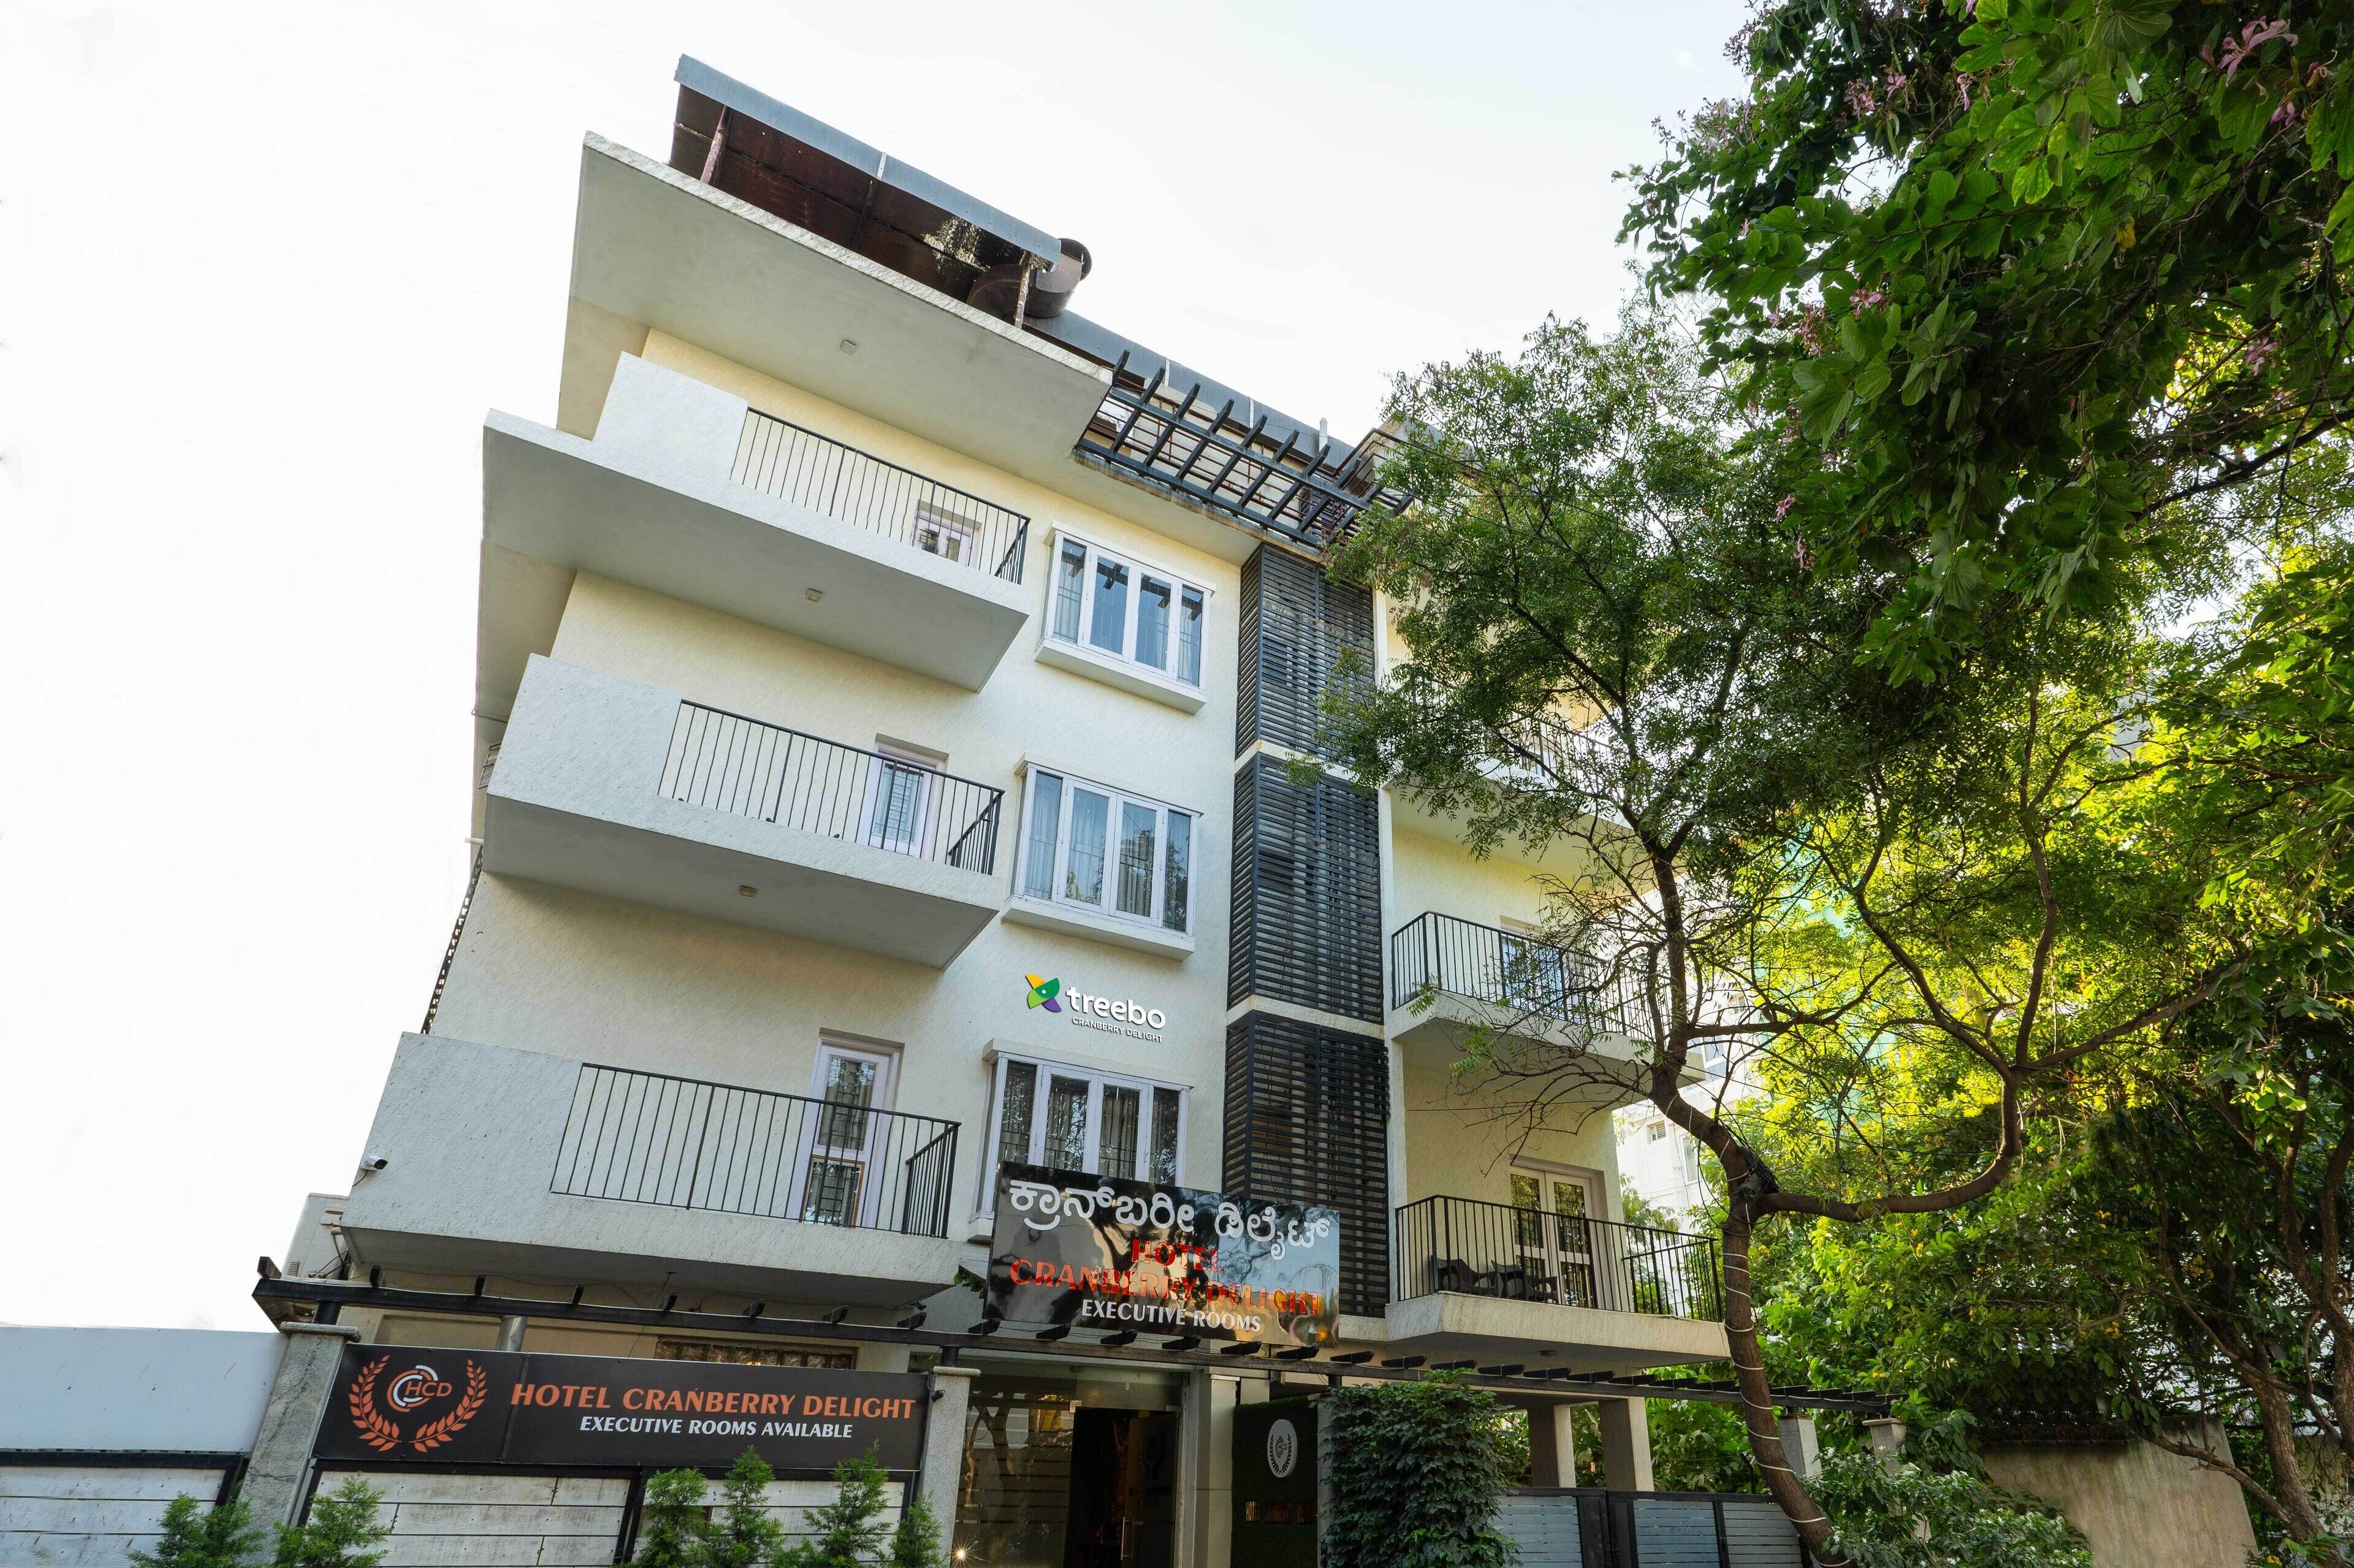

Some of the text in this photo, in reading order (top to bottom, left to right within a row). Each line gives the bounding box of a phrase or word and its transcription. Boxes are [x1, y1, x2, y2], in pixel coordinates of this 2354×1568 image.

[1066, 987, 1166, 1029] treebo
[1073, 1017, 1164, 1042] CRANBERRY DELIGHT
[1132, 1239, 1224, 1273] HOTEL
[1010, 1259, 1323, 1315] CRANBERRY DELIGHT
[1082, 1299, 1261, 1333] EXECUTIVE ROOMS
[405, 1381, 452, 1396] HCD
[511, 1383, 916, 1419] HOTEL CRANBERRY DELIGHT
[580, 1416, 853, 1438] EXECUTIVE ROOMS AVAILABLE
